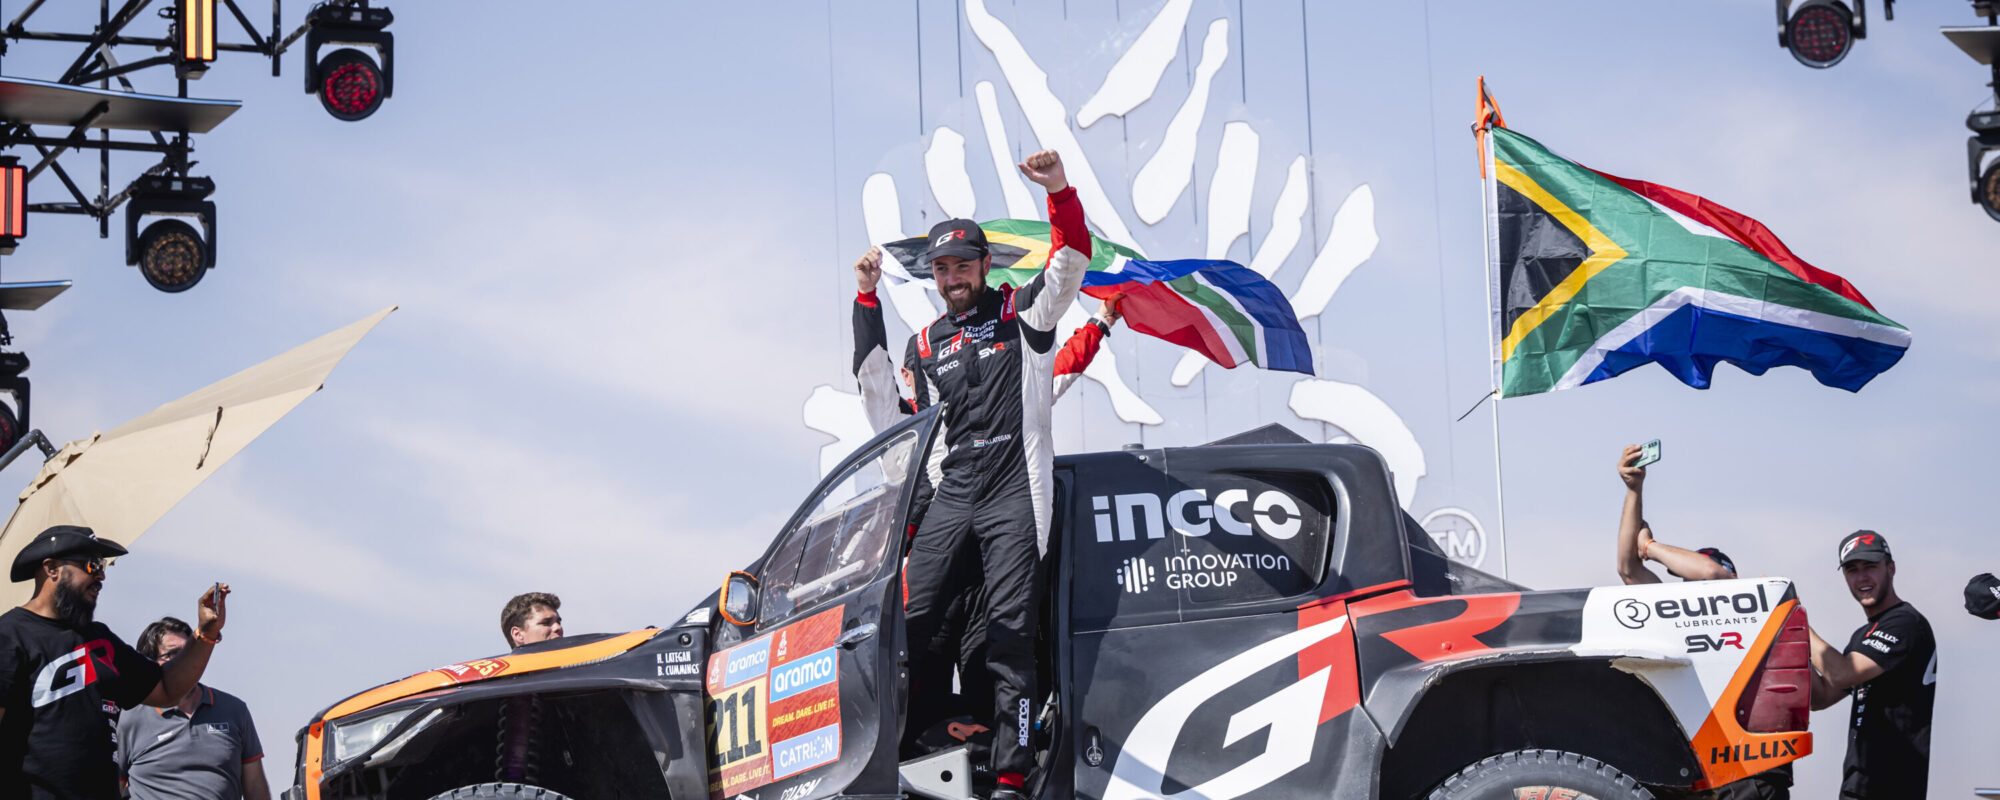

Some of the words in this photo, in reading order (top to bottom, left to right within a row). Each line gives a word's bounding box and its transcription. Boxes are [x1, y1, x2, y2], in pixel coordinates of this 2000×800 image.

[935, 230, 966, 247] GR
[938, 341, 963, 360] GR
[979, 342, 1006, 359] SVR
[1841, 534, 1875, 561] GR
[1166, 571, 1238, 590] GROUP
[1654, 584, 1769, 619] eurol
[1675, 616, 1758, 628] LUBRICANTS
[1685, 632, 1745, 653] SVR
[656, 653, 664, 664] H.
[665, 651, 692, 663] LATEGAN
[728, 650, 767, 674] aramco
[31, 638, 120, 708] GR
[657, 665, 665, 676] B.
[665, 664, 700, 676] CUMMINGS
[774, 656, 832, 693] aramco
[772, 714, 796, 728] DREAM.
[795, 705, 813, 720] DARE.
[814, 700, 828, 713] LIVE
[1018, 698, 1030, 747] sparco
[707, 685, 762, 770] 211
[1711, 738, 1799, 764] HILUX
